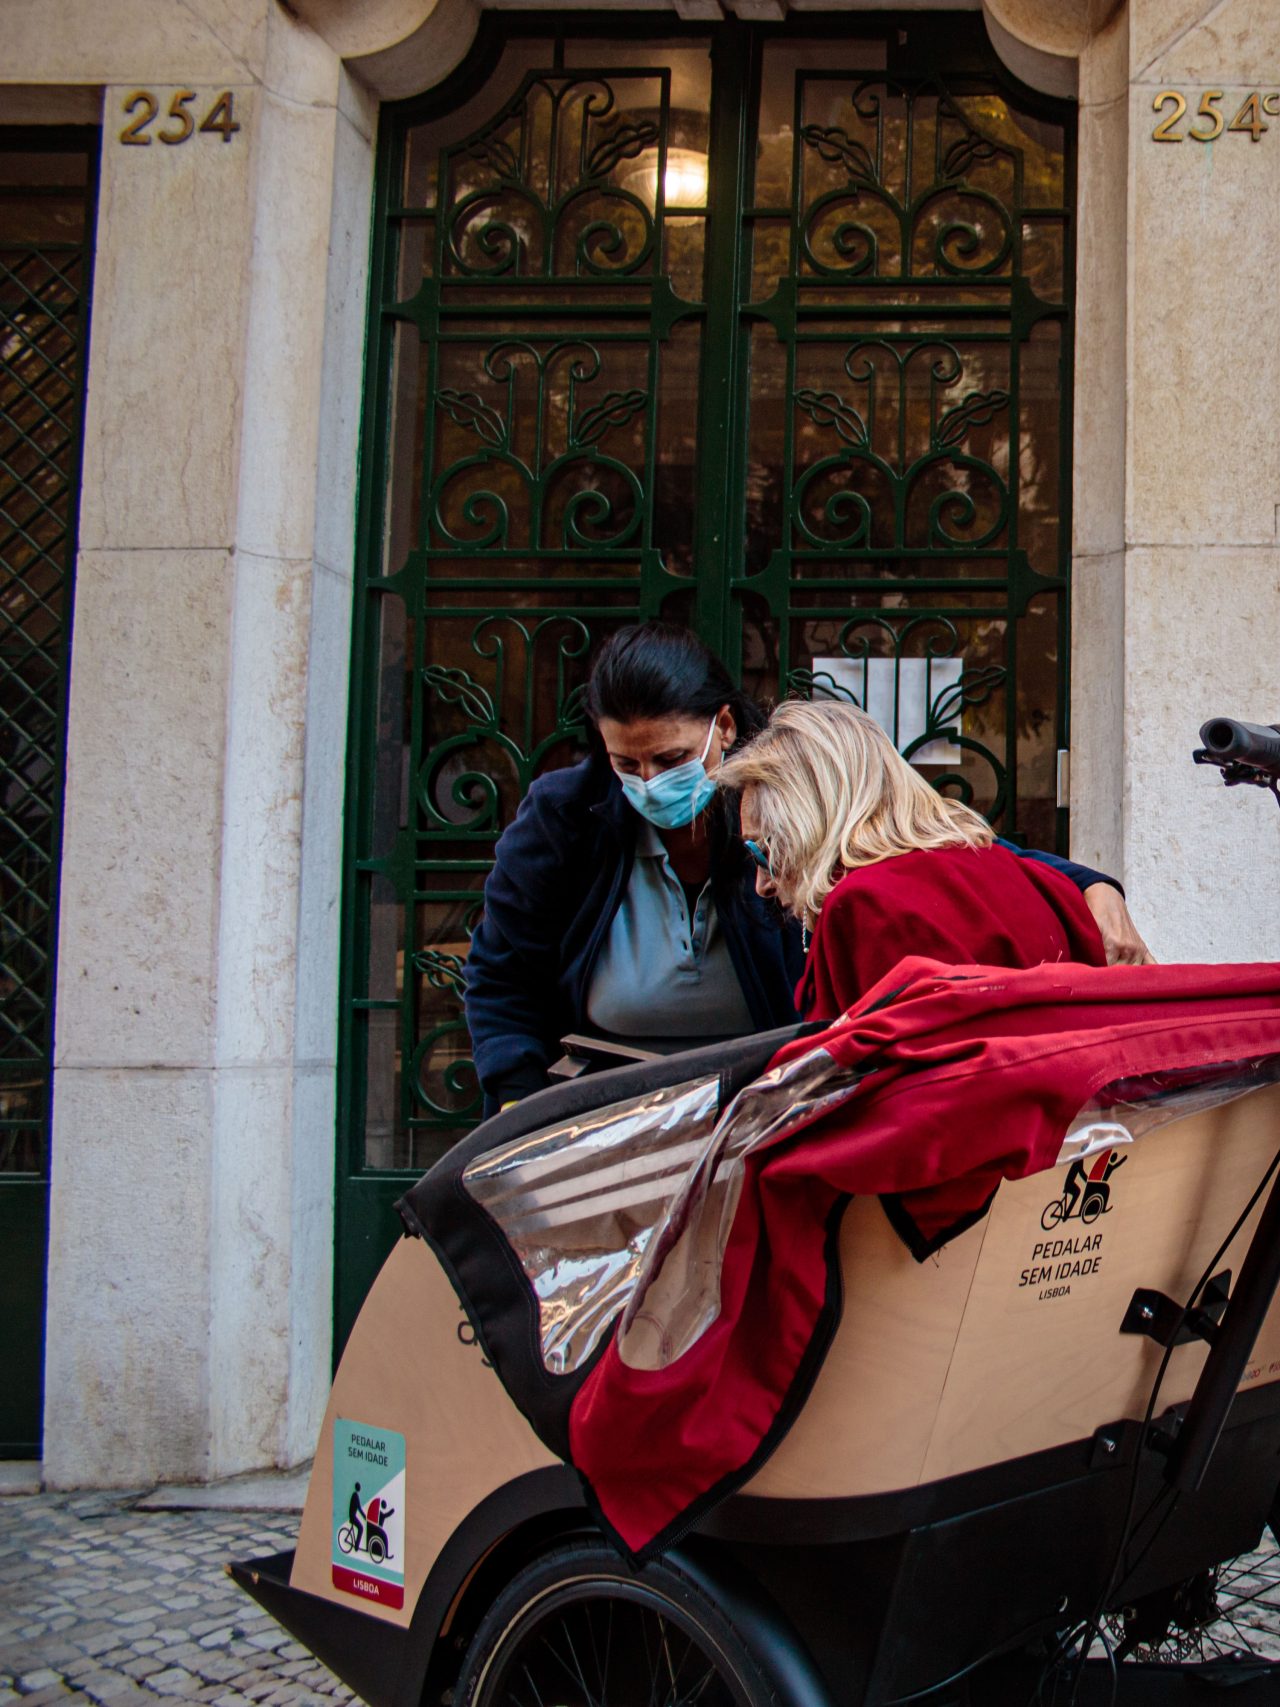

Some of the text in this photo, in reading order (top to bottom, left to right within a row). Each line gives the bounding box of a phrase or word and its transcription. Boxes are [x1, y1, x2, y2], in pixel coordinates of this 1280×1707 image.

[119, 90, 240, 145] 254
[1032, 1234, 1102, 1260] PEDALAR
[1018, 1257, 1102, 1287] SEM IDADE
[1038, 1285, 1071, 1301] LISBOA
[351, 1433, 386, 1452] PEDALAR
[348, 1446, 388, 1467] SEM IDADE
[353, 1578, 379, 1595] LISBOA
